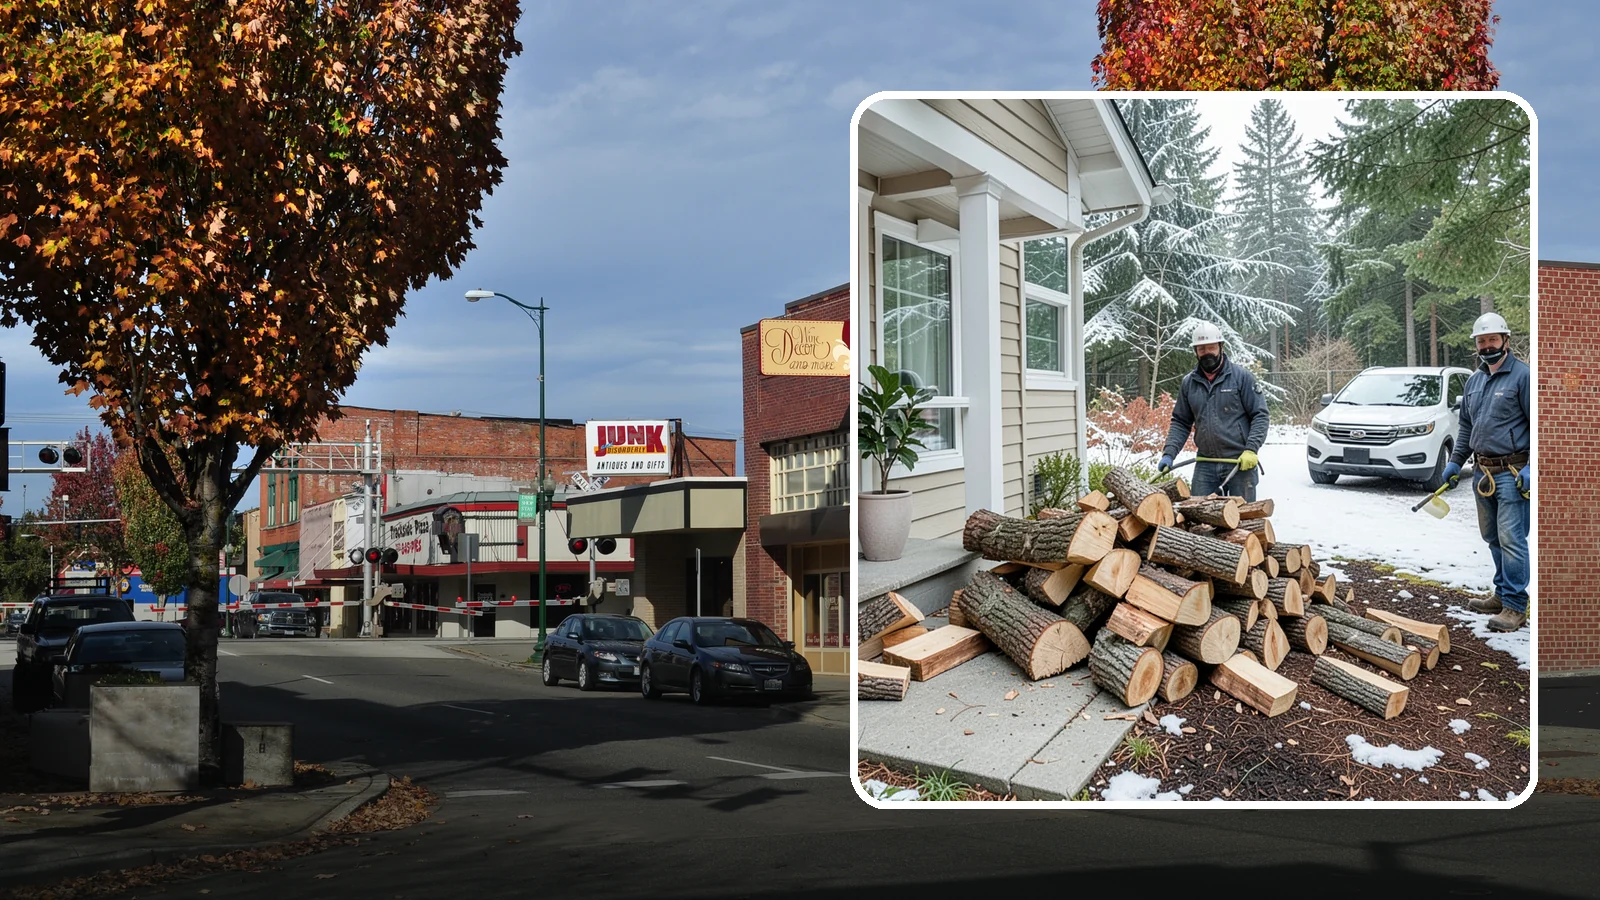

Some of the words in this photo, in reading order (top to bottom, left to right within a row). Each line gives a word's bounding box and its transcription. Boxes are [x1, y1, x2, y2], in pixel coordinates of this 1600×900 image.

[765, 328, 831, 365] Decor
[596, 425, 664, 457] JUNK
[607, 446, 646, 454] DISORDERLY
[597, 461, 628, 470] ANTIQUES
[631, 461, 643, 470] AND
[646, 460, 665, 469] GIFTS
[590, 476, 608, 491] SING
[414, 519, 429, 535] Pizza
